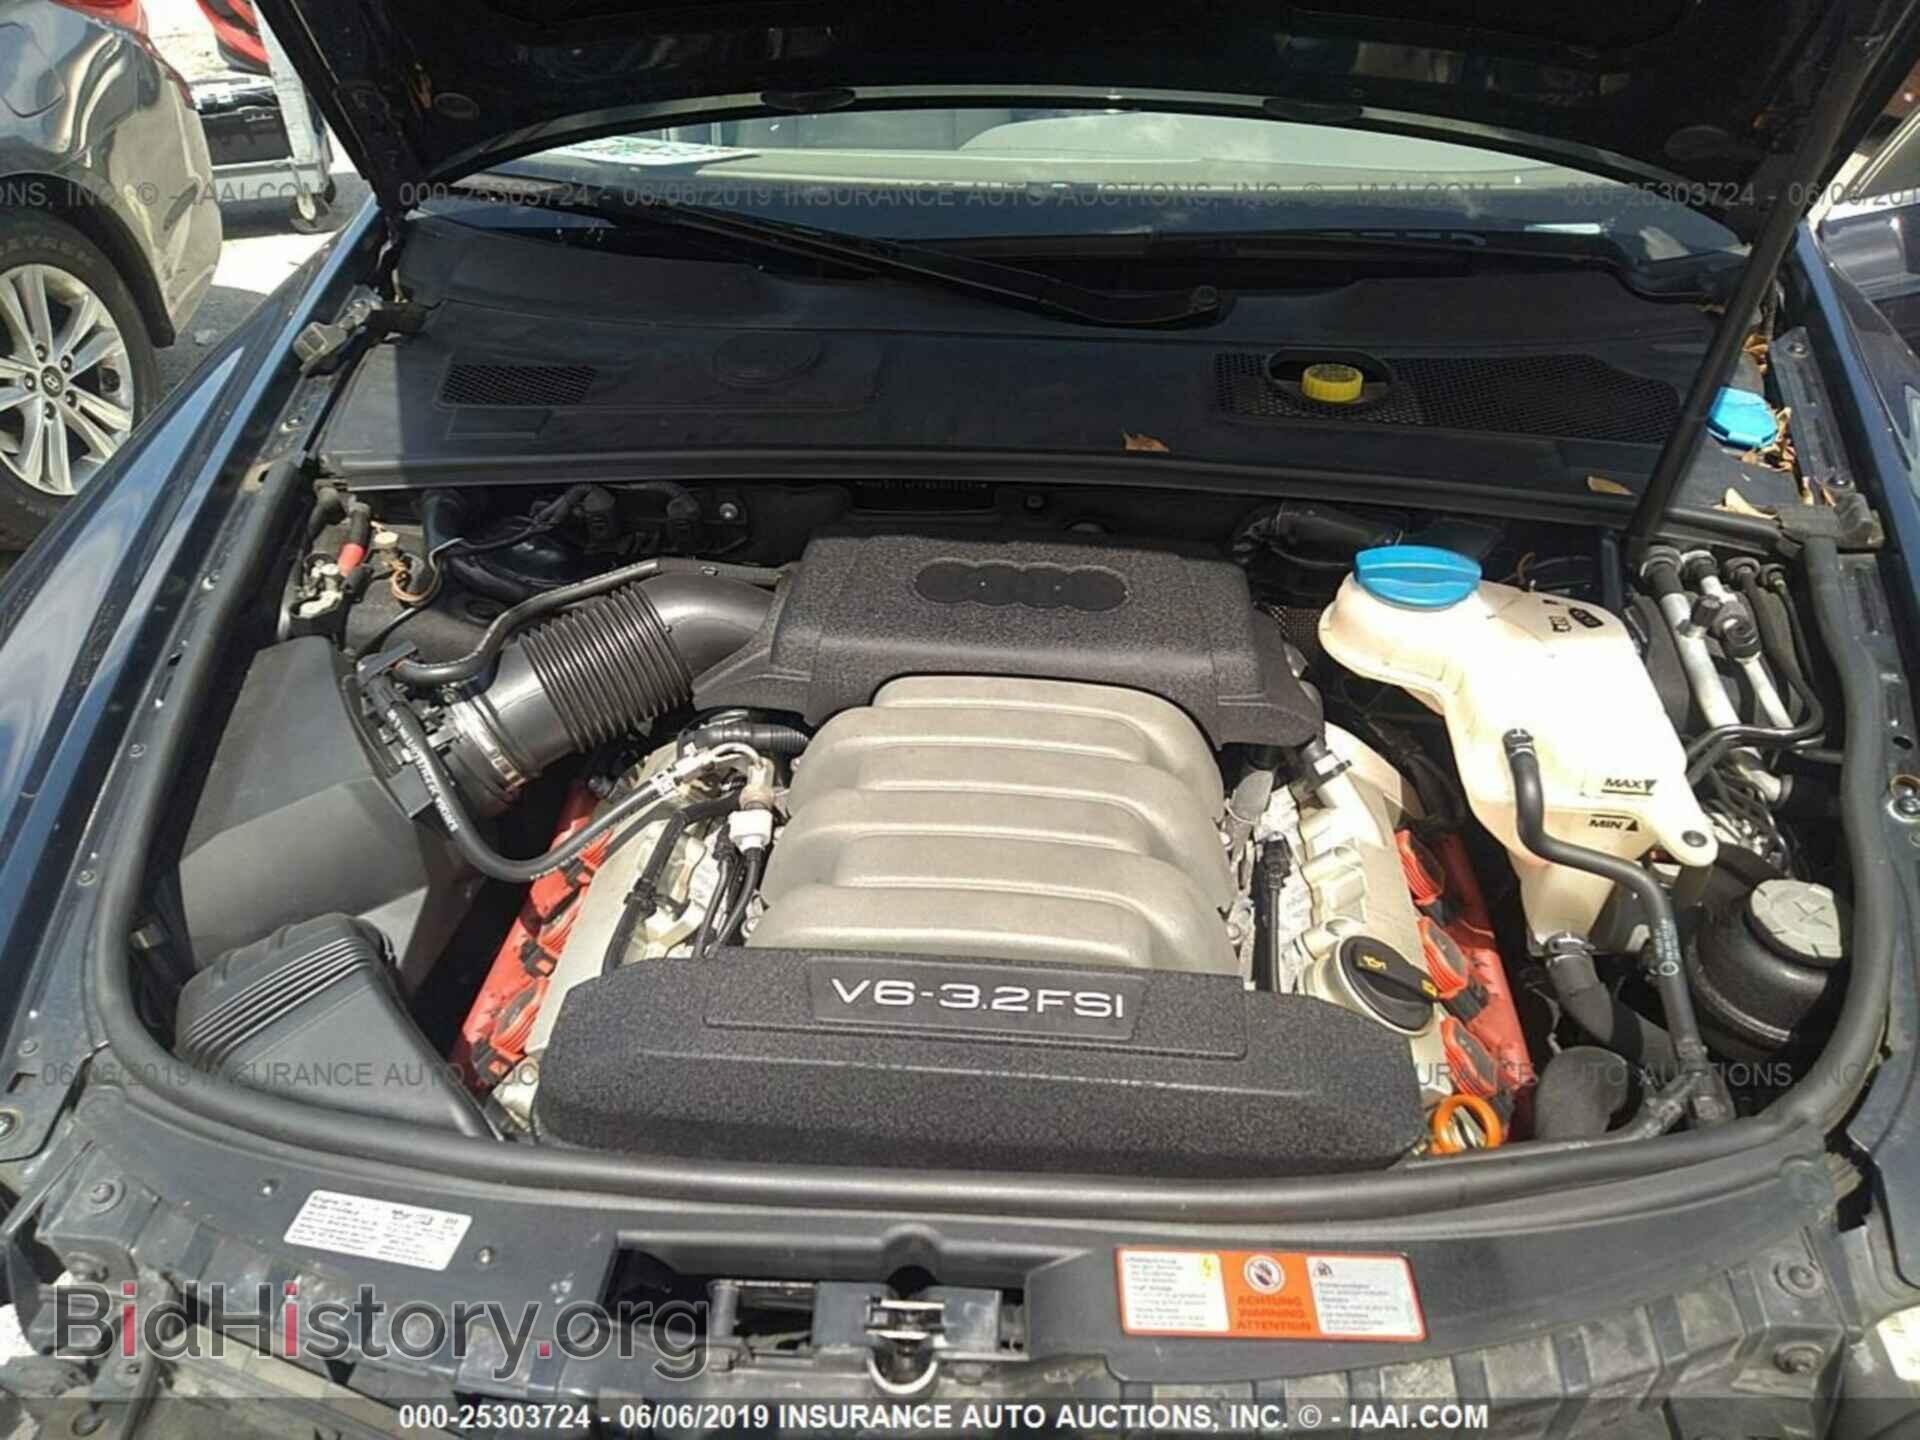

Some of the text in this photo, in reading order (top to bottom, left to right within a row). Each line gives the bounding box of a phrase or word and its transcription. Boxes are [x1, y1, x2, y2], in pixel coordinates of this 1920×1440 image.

[1604, 778, 1643, 790] MAX
[1588, 819, 1623, 830] MIN
[831, 978, 1124, 1018] V6-3.2FSI
